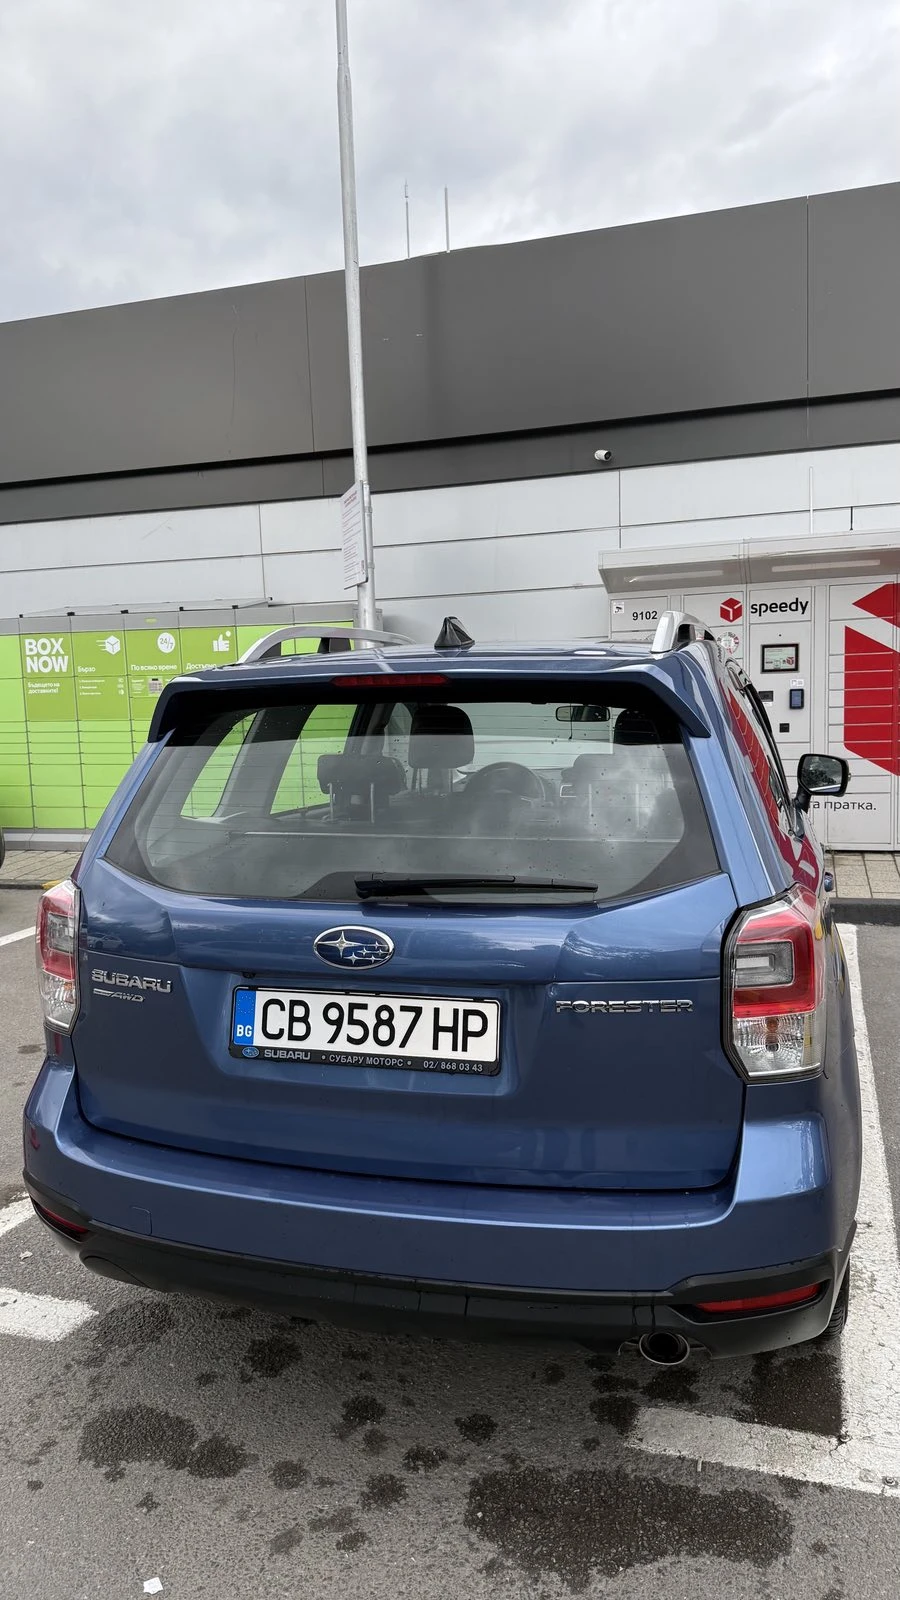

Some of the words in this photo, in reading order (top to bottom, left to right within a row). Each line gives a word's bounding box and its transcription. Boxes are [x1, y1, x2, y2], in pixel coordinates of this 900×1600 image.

[750, 597, 809, 617] speedy
[632, 611, 658, 621] 9102
[24, 637, 65, 656] BOX
[159, 637, 174, 649] 24/7
[26, 655, 69, 673] NOW
[158, 664, 177, 672] време
[824, 801, 877, 811] пратка.
[91, 968, 172, 993] SUBARU
[111, 991, 145, 1002] AWD
[555, 999, 694, 1013] FORESTER
[236, 1024, 253, 1037] BG
[261, 998, 312, 1042] CB
[322, 1001, 423, 1049] 9587
[432, 1006, 489, 1052] HP
[264, 1048, 311, 1060] SUBARU
[329, 1054, 364, 1064] СУБАРУ
[366, 1056, 404, 1067] МОТОРС
[423, 1060, 439, 1069] 02/
[440, 1061, 457, 1070] 868
[458, 1062, 470, 1071] 03
[471, 1063, 483, 1072] 43
